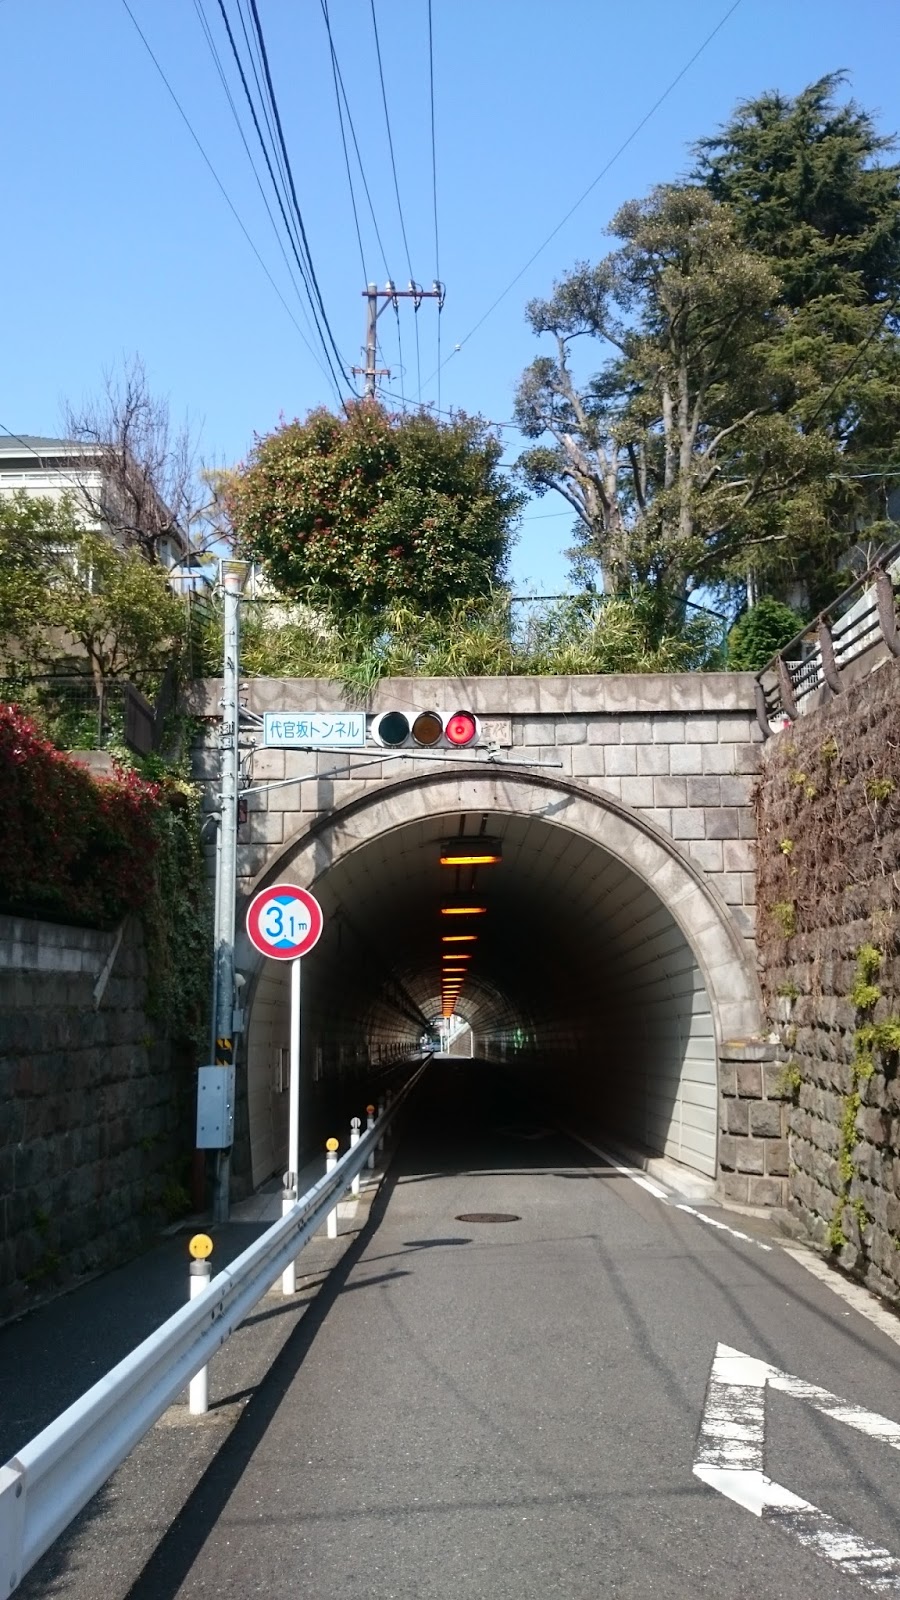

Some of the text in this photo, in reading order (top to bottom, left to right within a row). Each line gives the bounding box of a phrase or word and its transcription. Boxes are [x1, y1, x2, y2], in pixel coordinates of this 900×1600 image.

[270, 721, 360, 739] 代官坂トンネル
